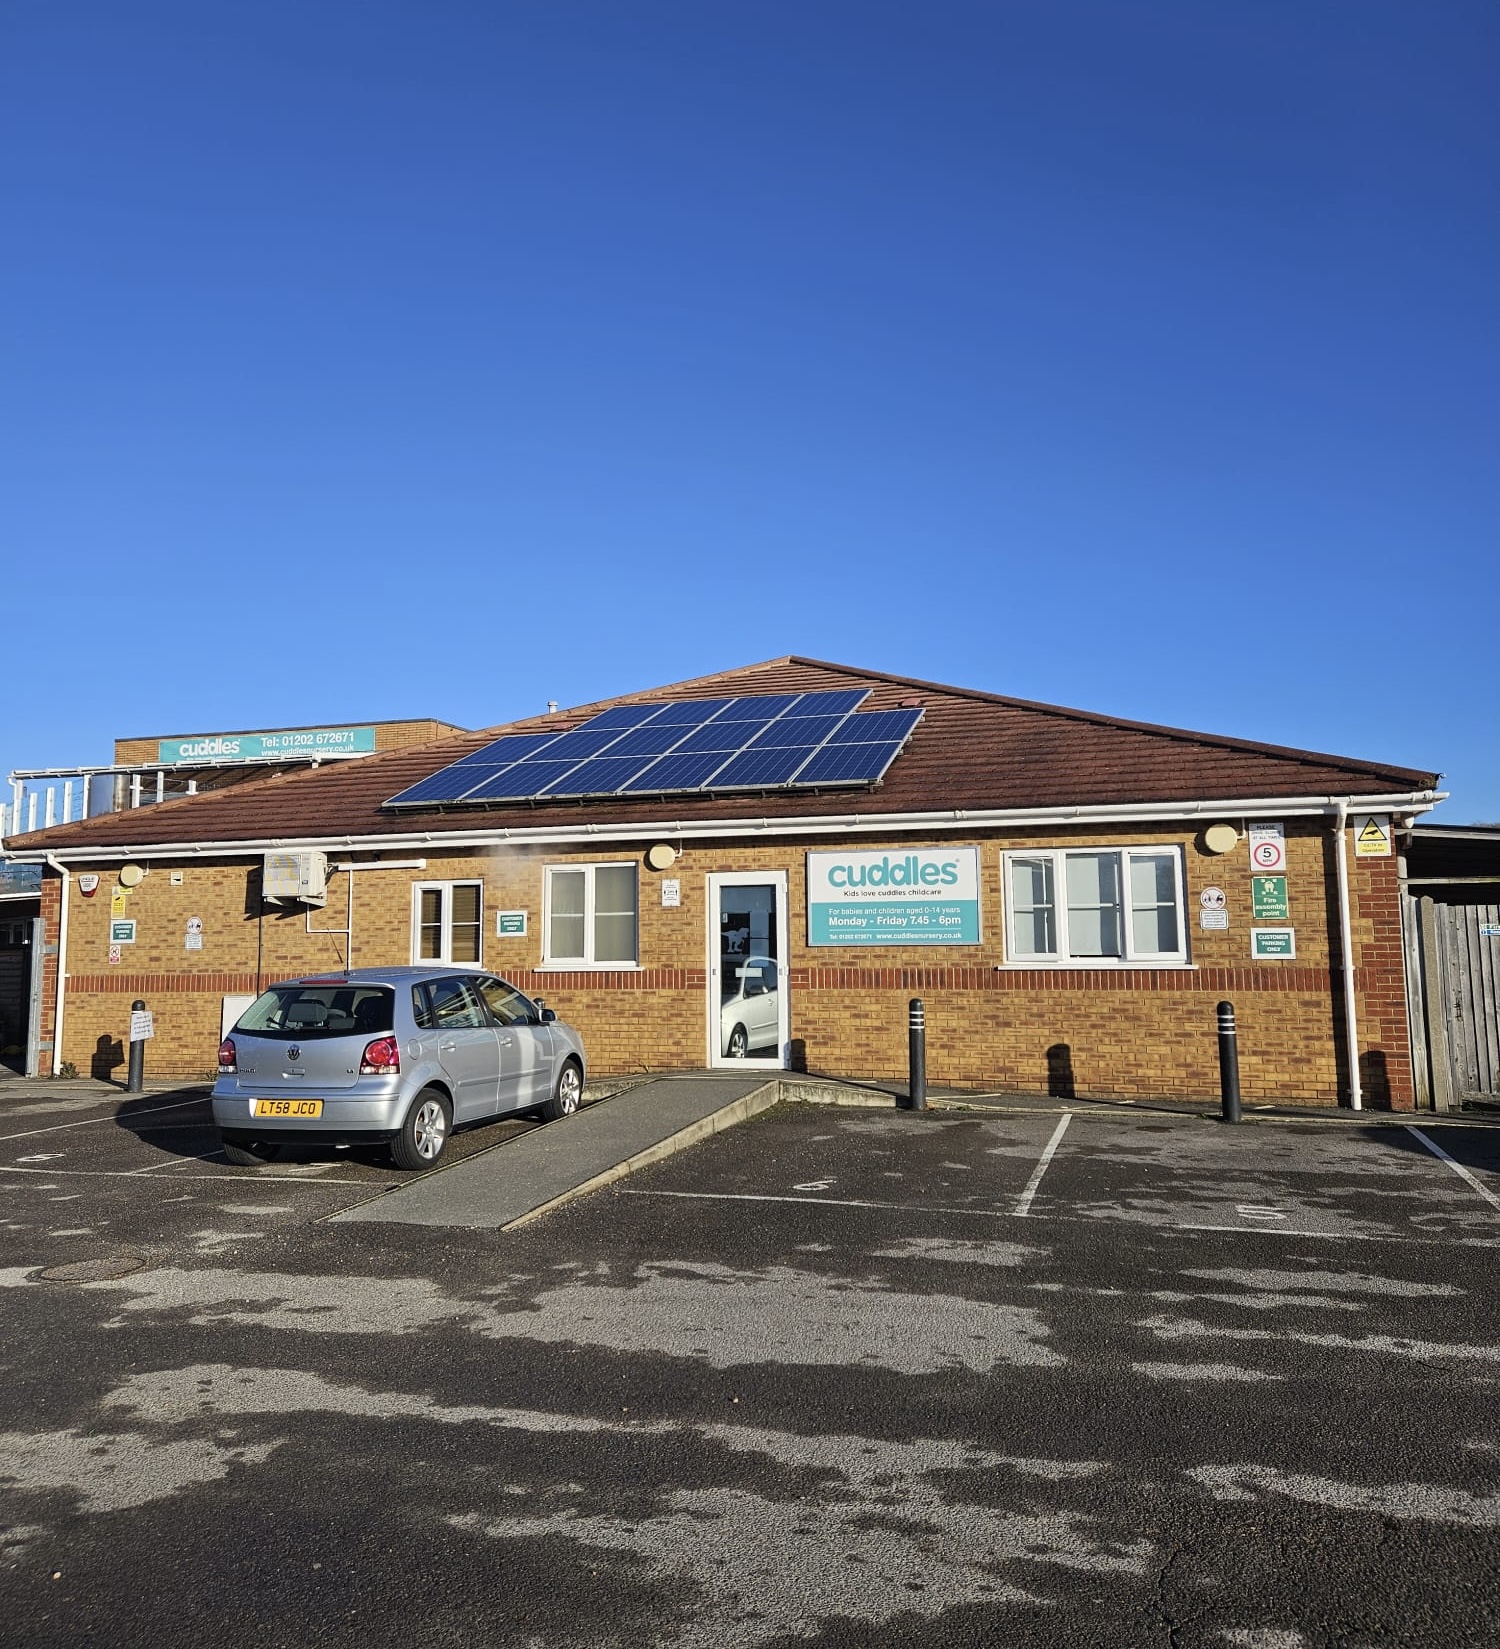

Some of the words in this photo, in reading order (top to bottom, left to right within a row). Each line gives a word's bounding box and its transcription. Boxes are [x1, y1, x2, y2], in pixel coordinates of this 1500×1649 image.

[261, 736, 280, 747] Tel:
[282, 734, 313, 746] 01202
[316, 732, 354, 744] 672671
[179, 738, 240, 757] cuddles
[1263, 847, 1272, 858] 5
[828, 855, 958, 888] cuddles
[864, 907, 877, 915] and
[878, 907, 905, 915] children
[906, 907, 923, 916] aged
[942, 907, 961, 916] years
[1255, 903, 1287, 911] assembly
[828, 917, 867, 927] Monday
[877, 916, 908, 927] Friday
[910, 916, 929, 925] 7.45
[938, 916, 961, 926] 6pm
[260, 1102, 290, 1114] LT58
[292, 1102, 316, 1114] JCO
